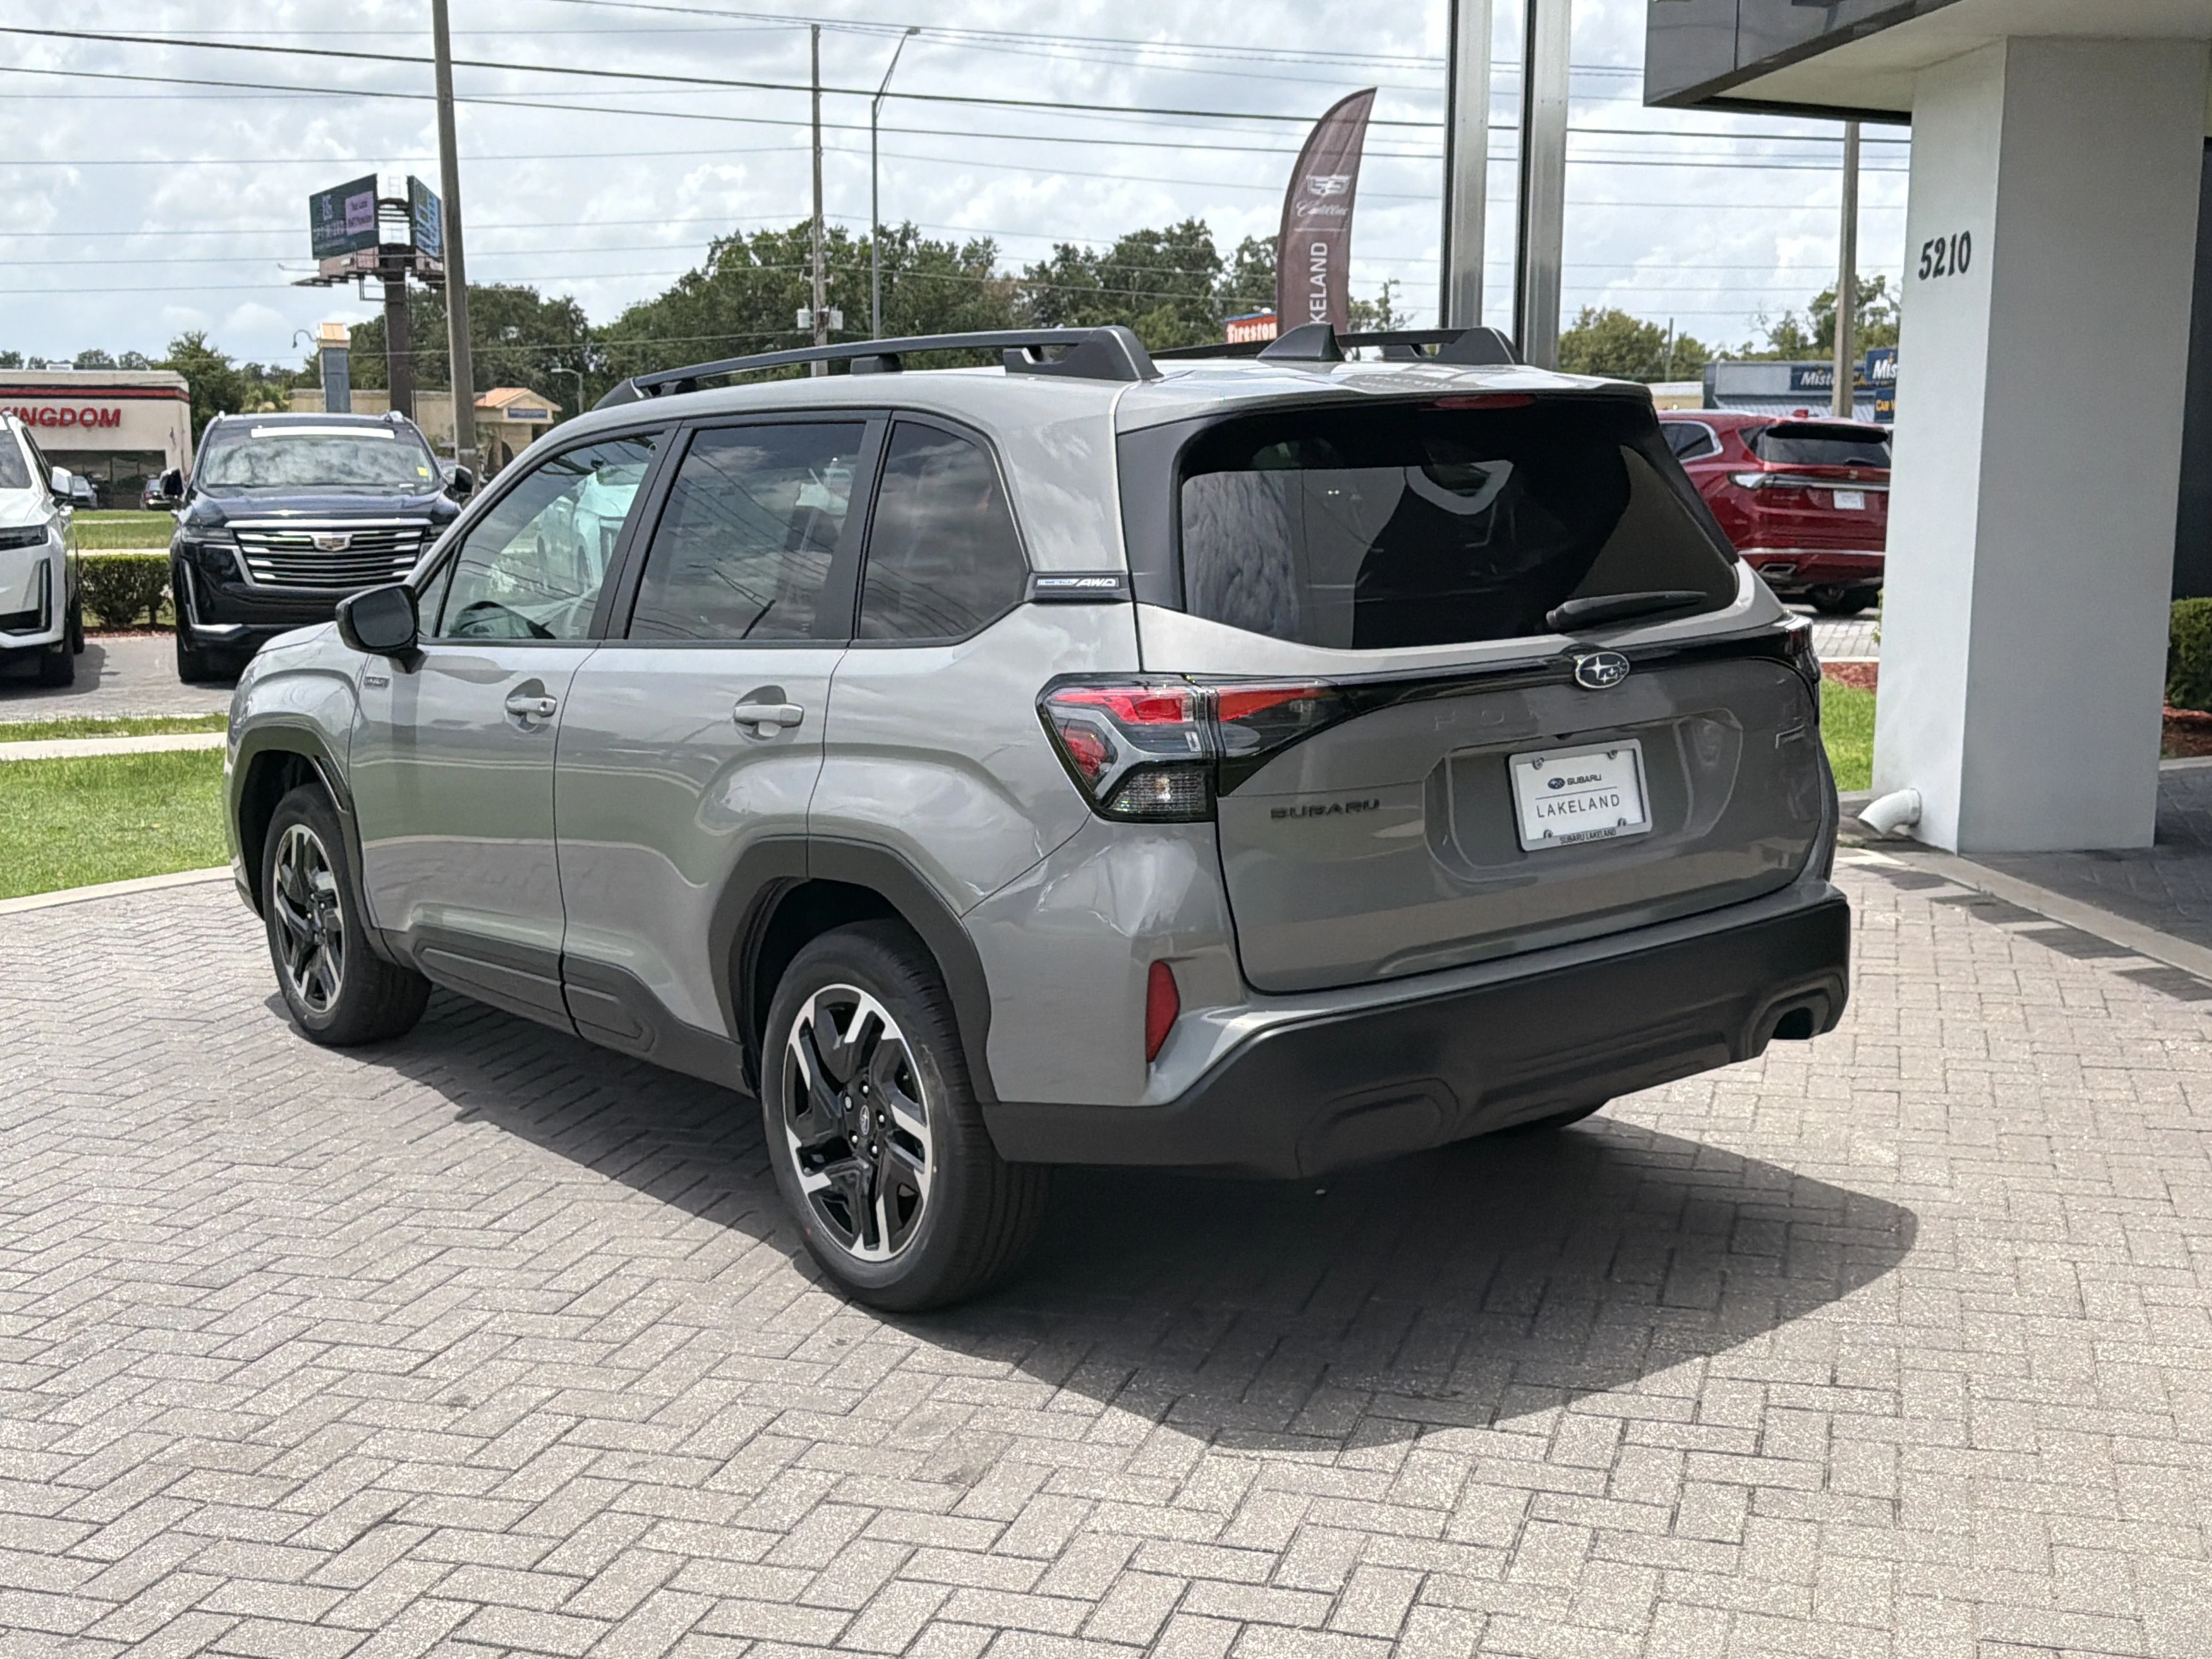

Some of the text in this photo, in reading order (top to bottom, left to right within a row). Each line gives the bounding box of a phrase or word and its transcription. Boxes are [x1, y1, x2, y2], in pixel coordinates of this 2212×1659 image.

[1918, 230, 1971, 280] 5210
[1, 407, 121, 427] NGDOM
[1075, 578, 1116, 587] AWD
[1567, 774, 1602, 786] SUBARU
[1271, 799, 1380, 819] SUBARU
[1537, 794, 1620, 818] LAKELAND
[1560, 828, 1617, 844] SUBARU LAKELAND
